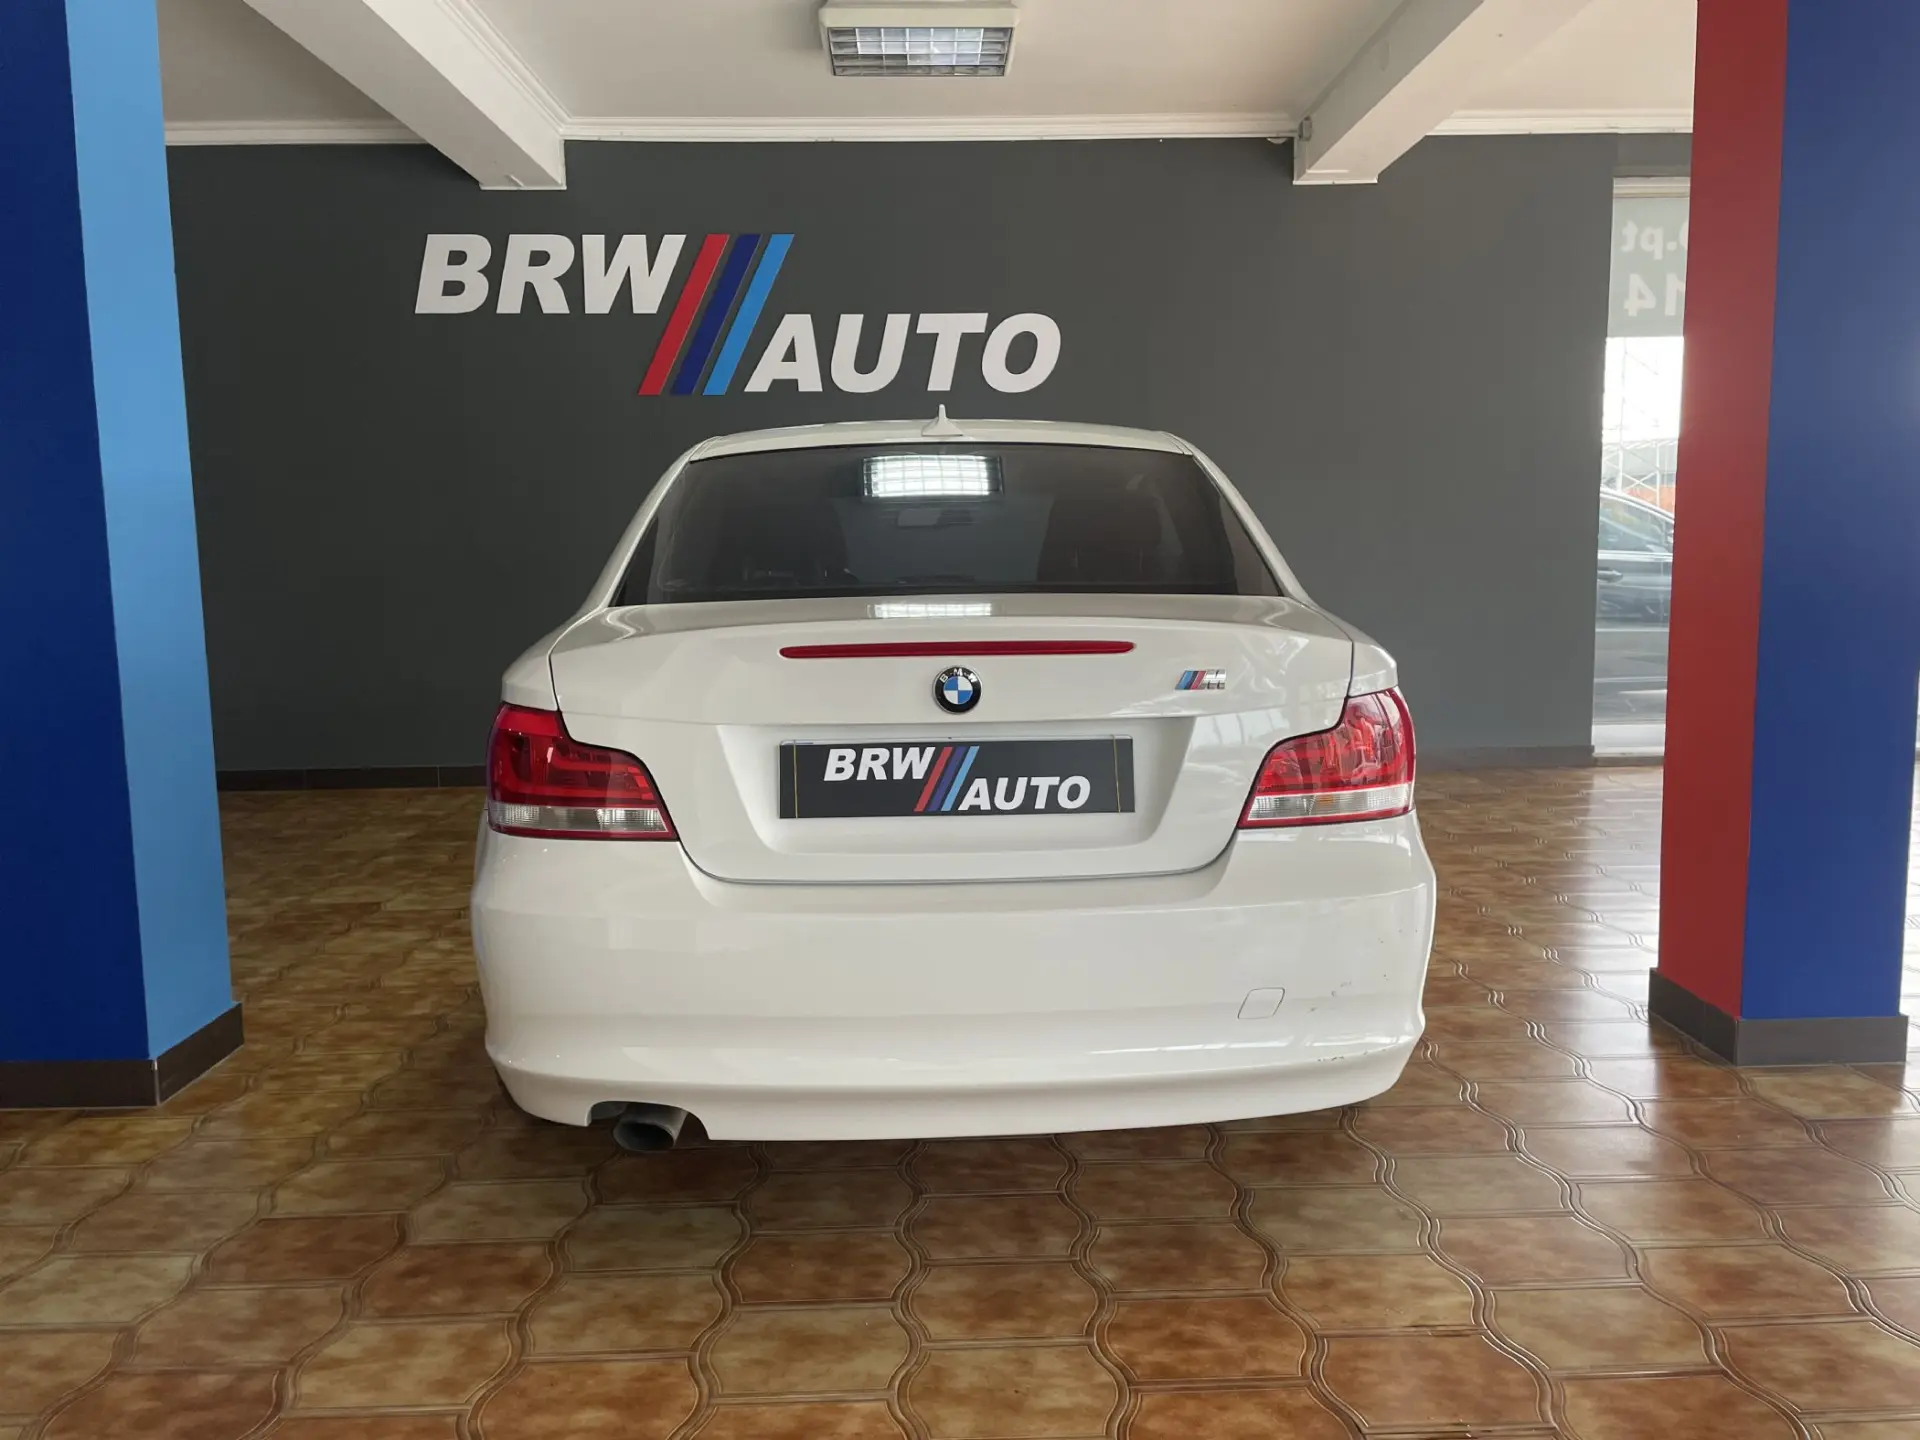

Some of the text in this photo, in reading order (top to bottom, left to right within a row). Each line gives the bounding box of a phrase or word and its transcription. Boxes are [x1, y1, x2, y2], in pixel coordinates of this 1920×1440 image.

[414, 233, 687, 315] BRW
[744, 312, 1062, 393] AUTO
[939, 668, 978, 683] BMW
[823, 746, 936, 781] BRW
[957, 775, 1091, 812] AUTO
